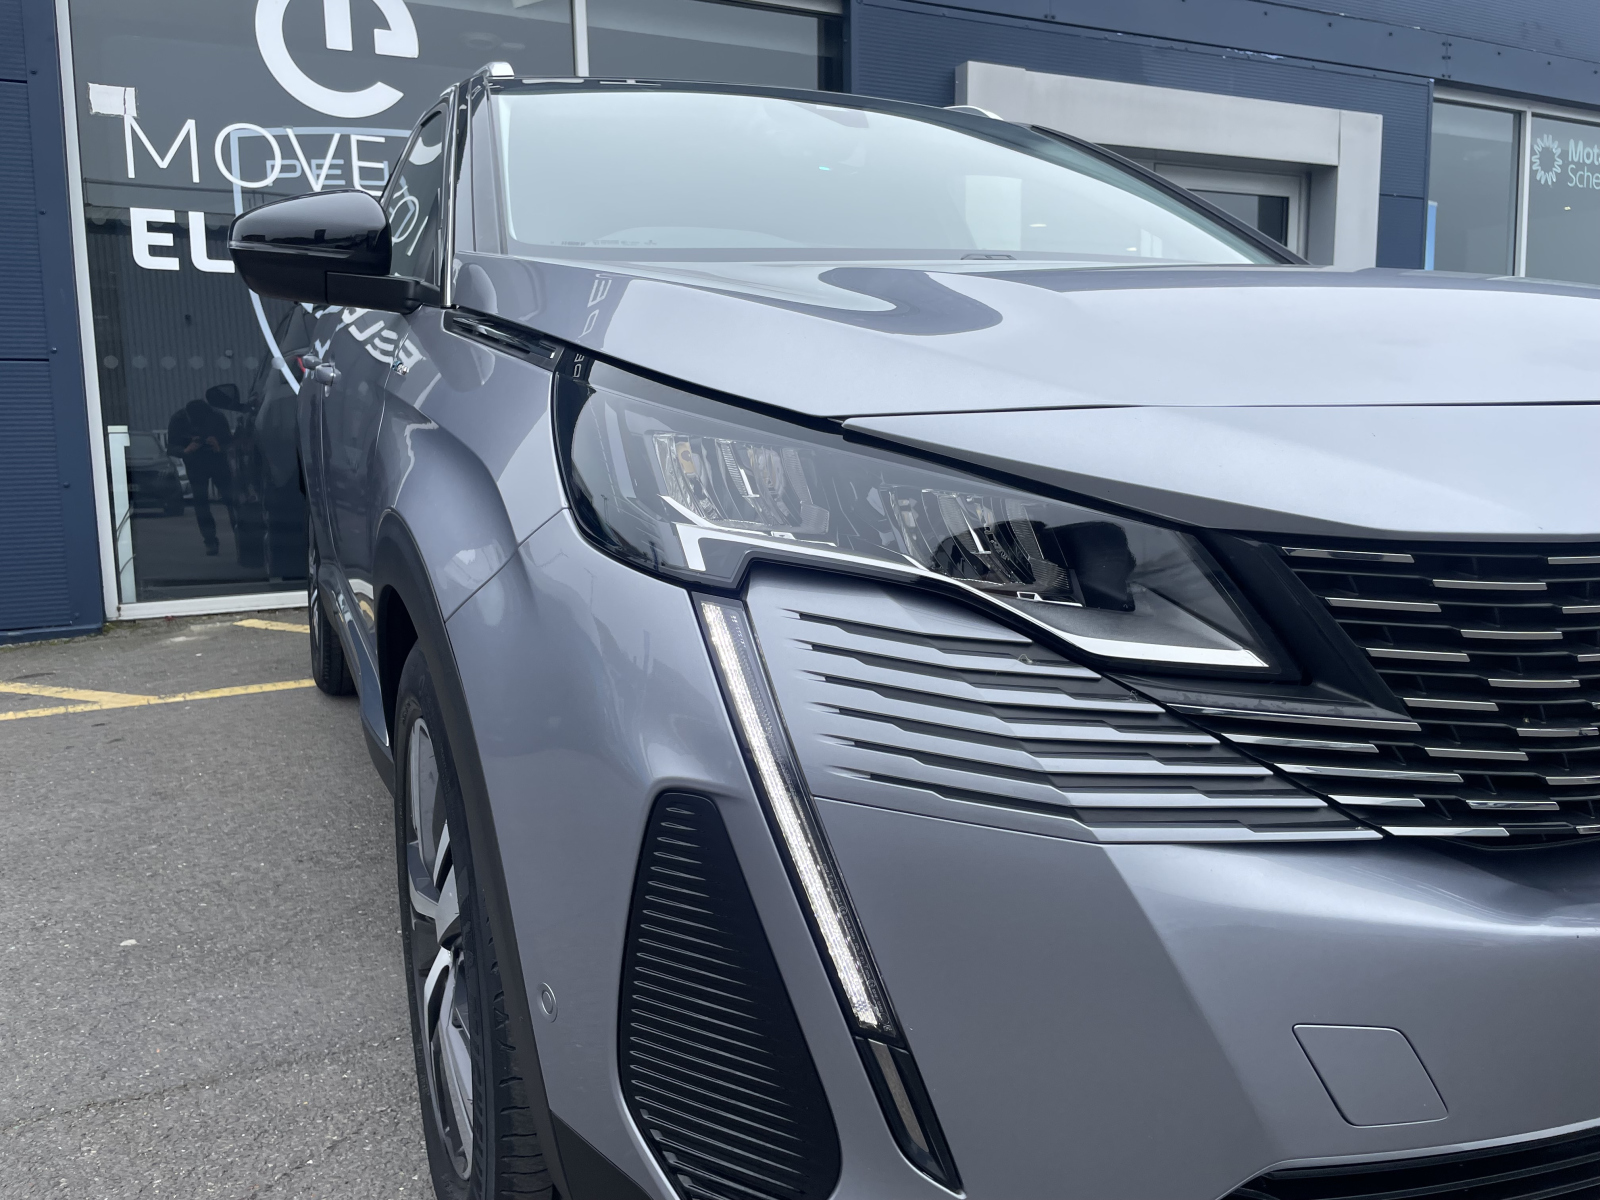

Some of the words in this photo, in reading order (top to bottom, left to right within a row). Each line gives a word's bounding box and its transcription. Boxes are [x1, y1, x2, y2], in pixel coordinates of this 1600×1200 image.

[122, 114, 386, 197] MOVE
[1568, 138, 1600, 166] Mot
[1568, 164, 1600, 190] Sche
[130, 207, 235, 274] EL
